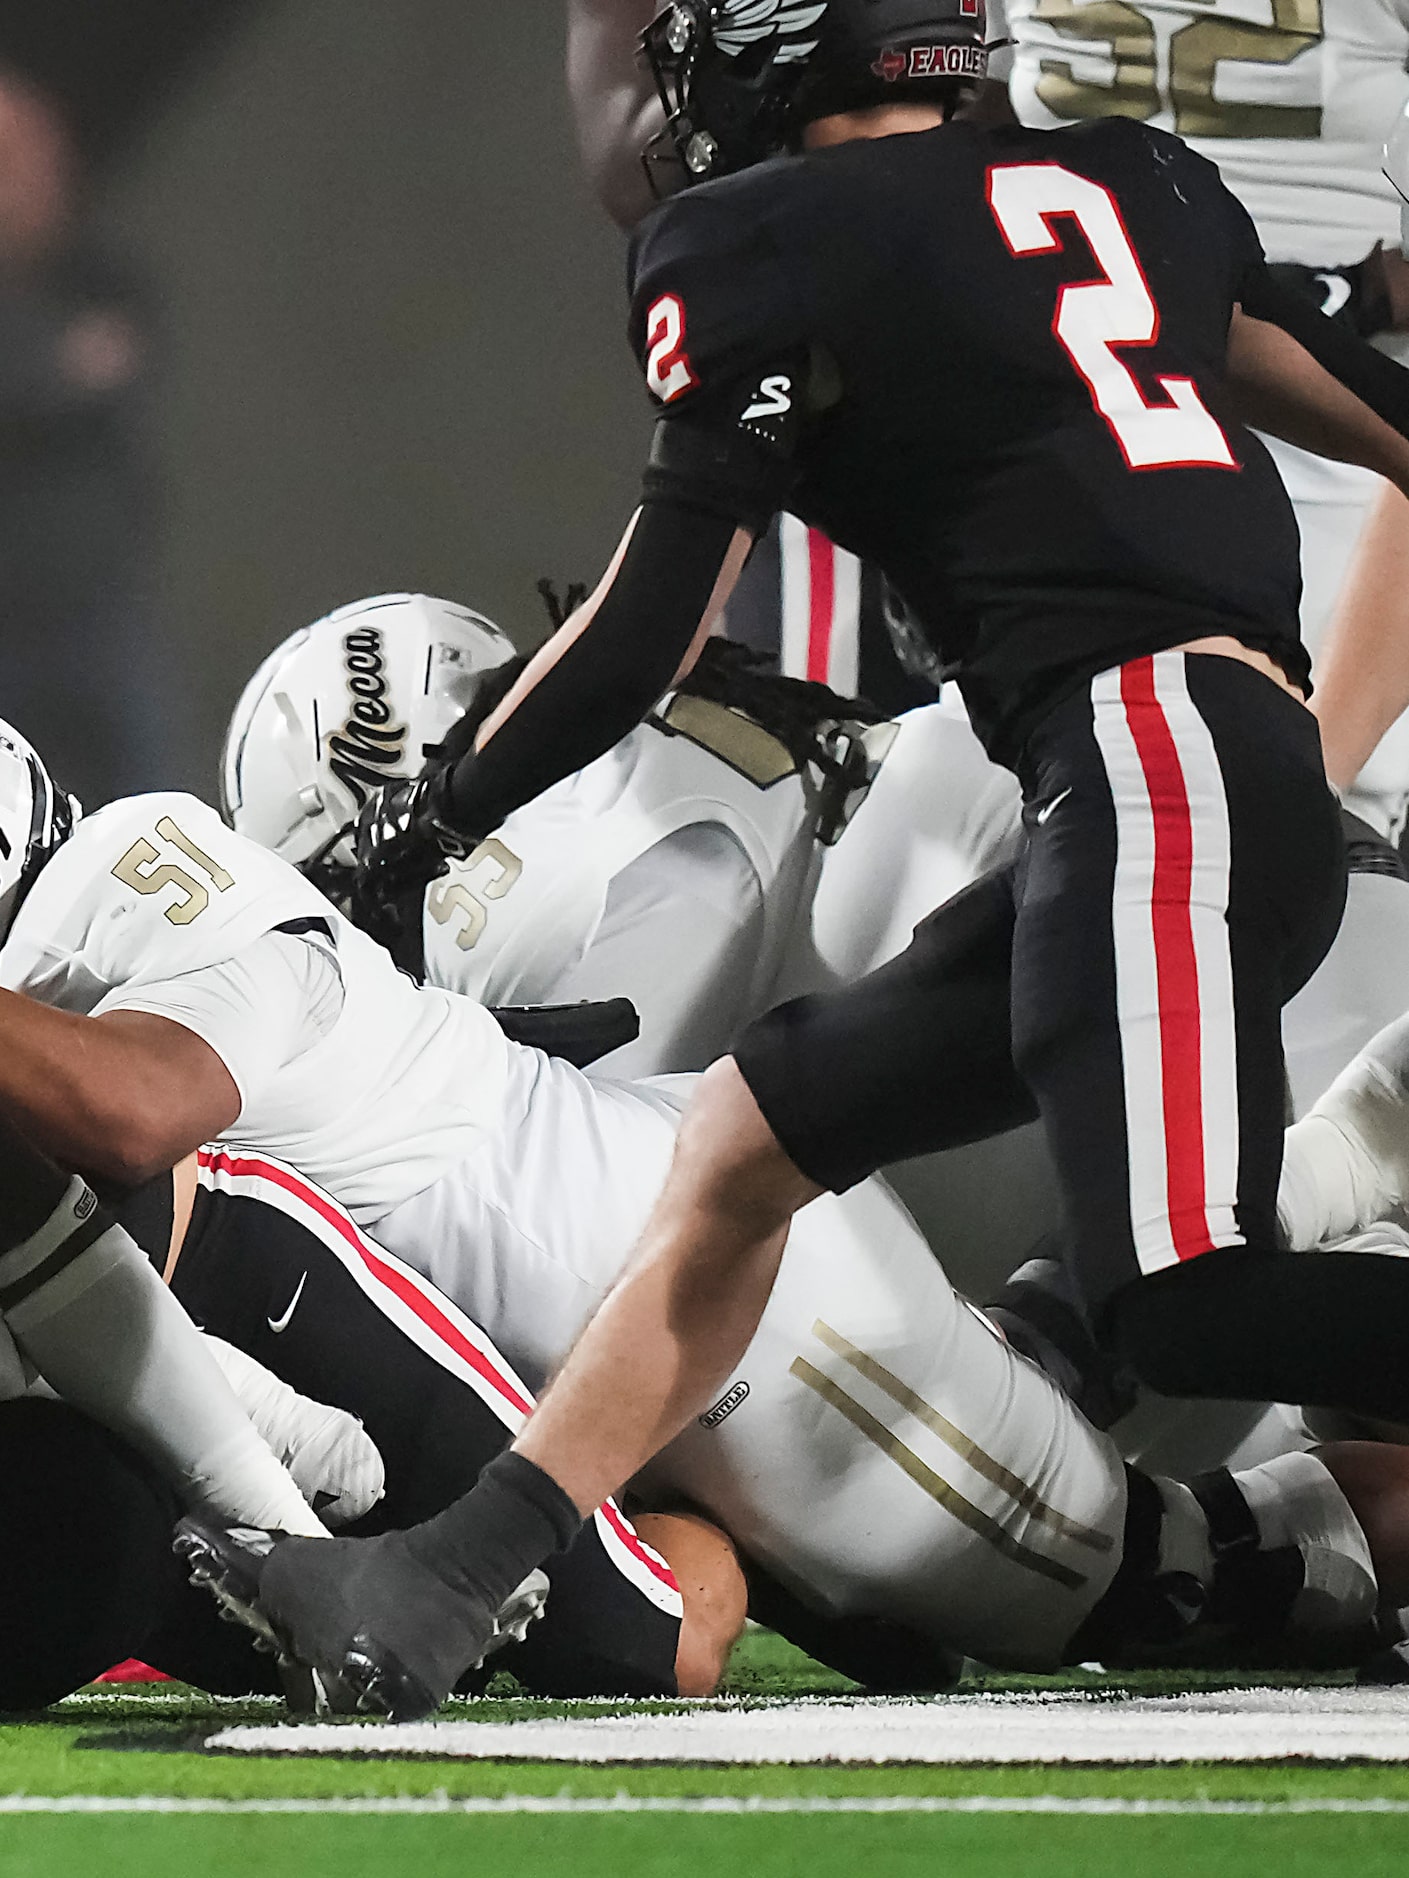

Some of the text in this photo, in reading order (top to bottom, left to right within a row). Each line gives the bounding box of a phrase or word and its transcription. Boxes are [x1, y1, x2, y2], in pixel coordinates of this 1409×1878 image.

[645, 292, 701, 403] 2
[986, 160, 1242, 472] 2
[329, 626, 406, 811] Mecca
[111, 815, 235, 926] 51
